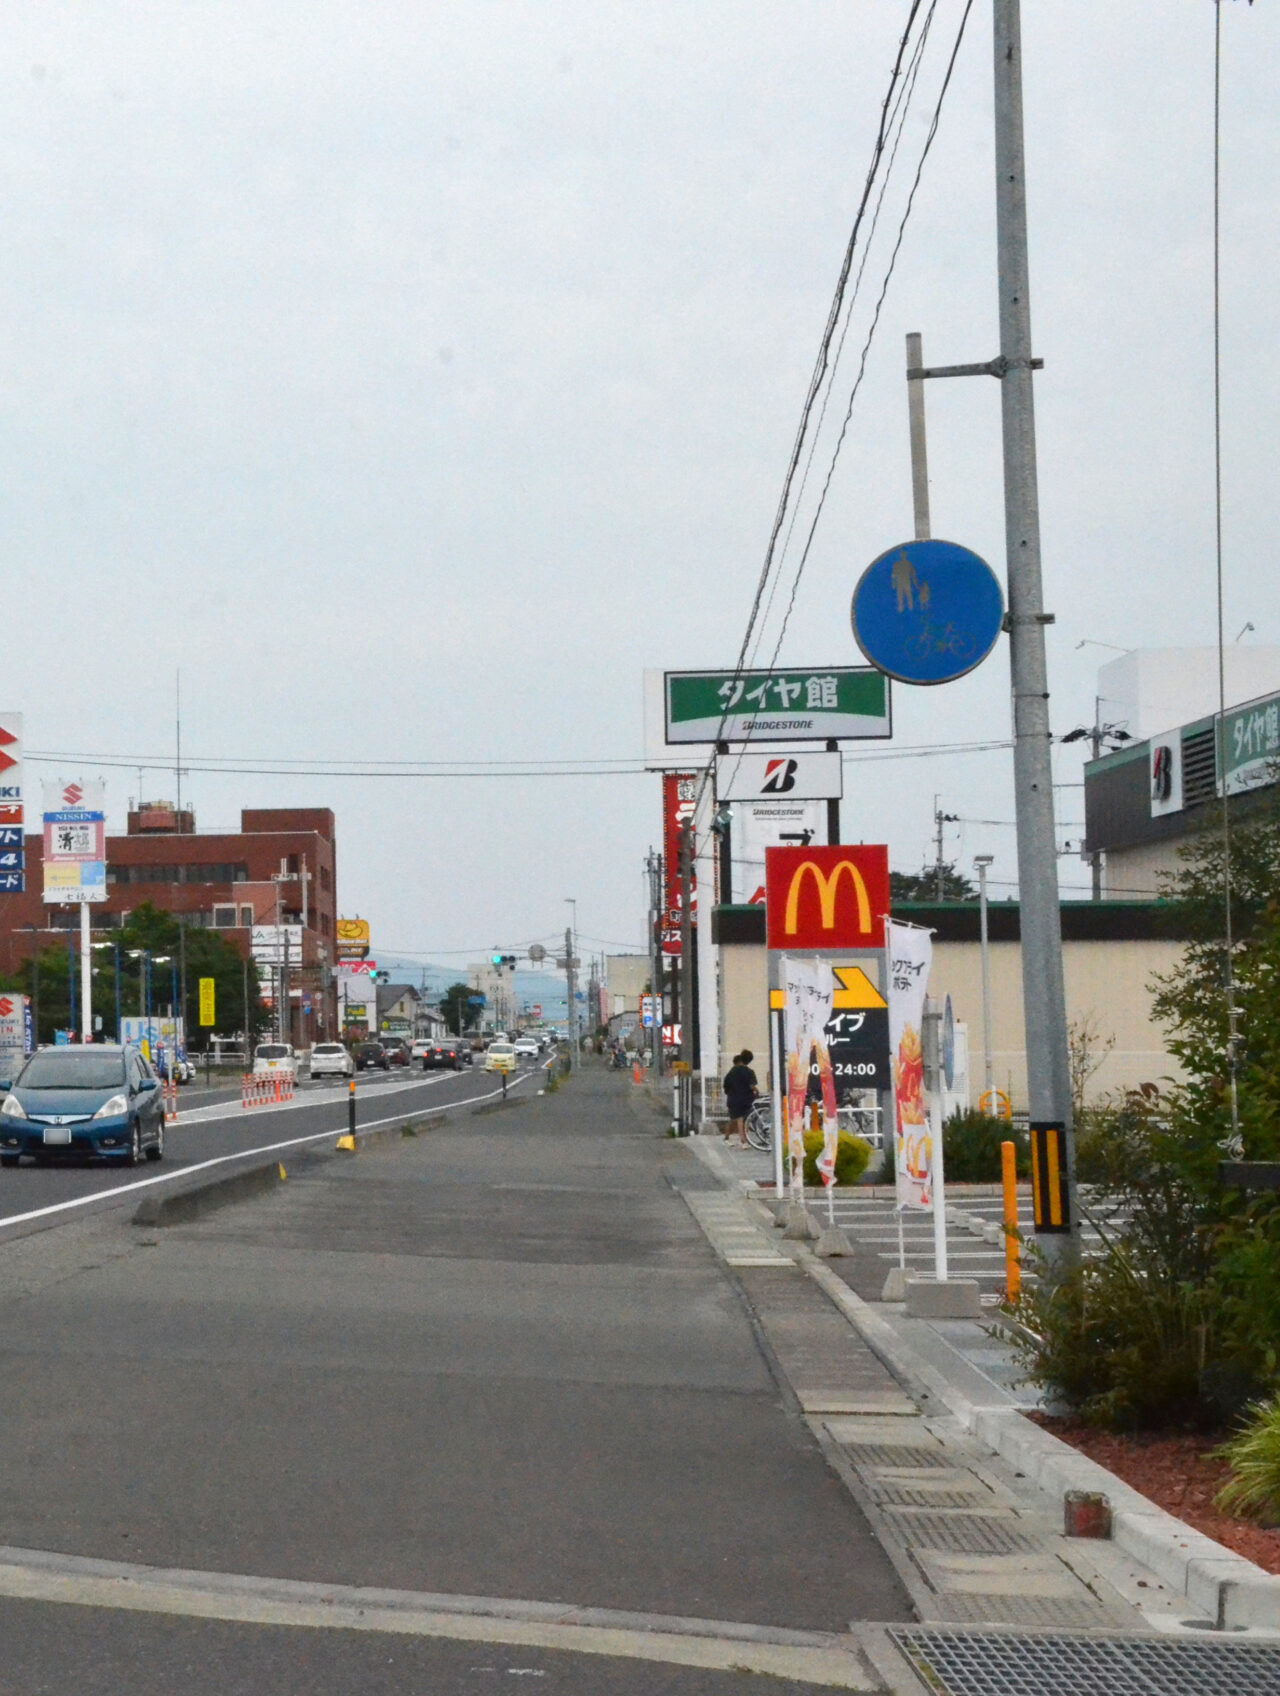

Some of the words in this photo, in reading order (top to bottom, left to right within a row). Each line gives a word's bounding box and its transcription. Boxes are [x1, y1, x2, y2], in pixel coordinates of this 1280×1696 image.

[717, 676, 839, 710] タイヤ館
[742, 719, 814, 731] BRIDGESTONE
[1233, 703, 1278, 759] タイヤ館
[56, 813, 92, 821] NISSIN
[827, 1012, 866, 1032] イブ
[825, 1033, 851, 1046] ルー
[835, 1063, 876, 1076] 24:00
